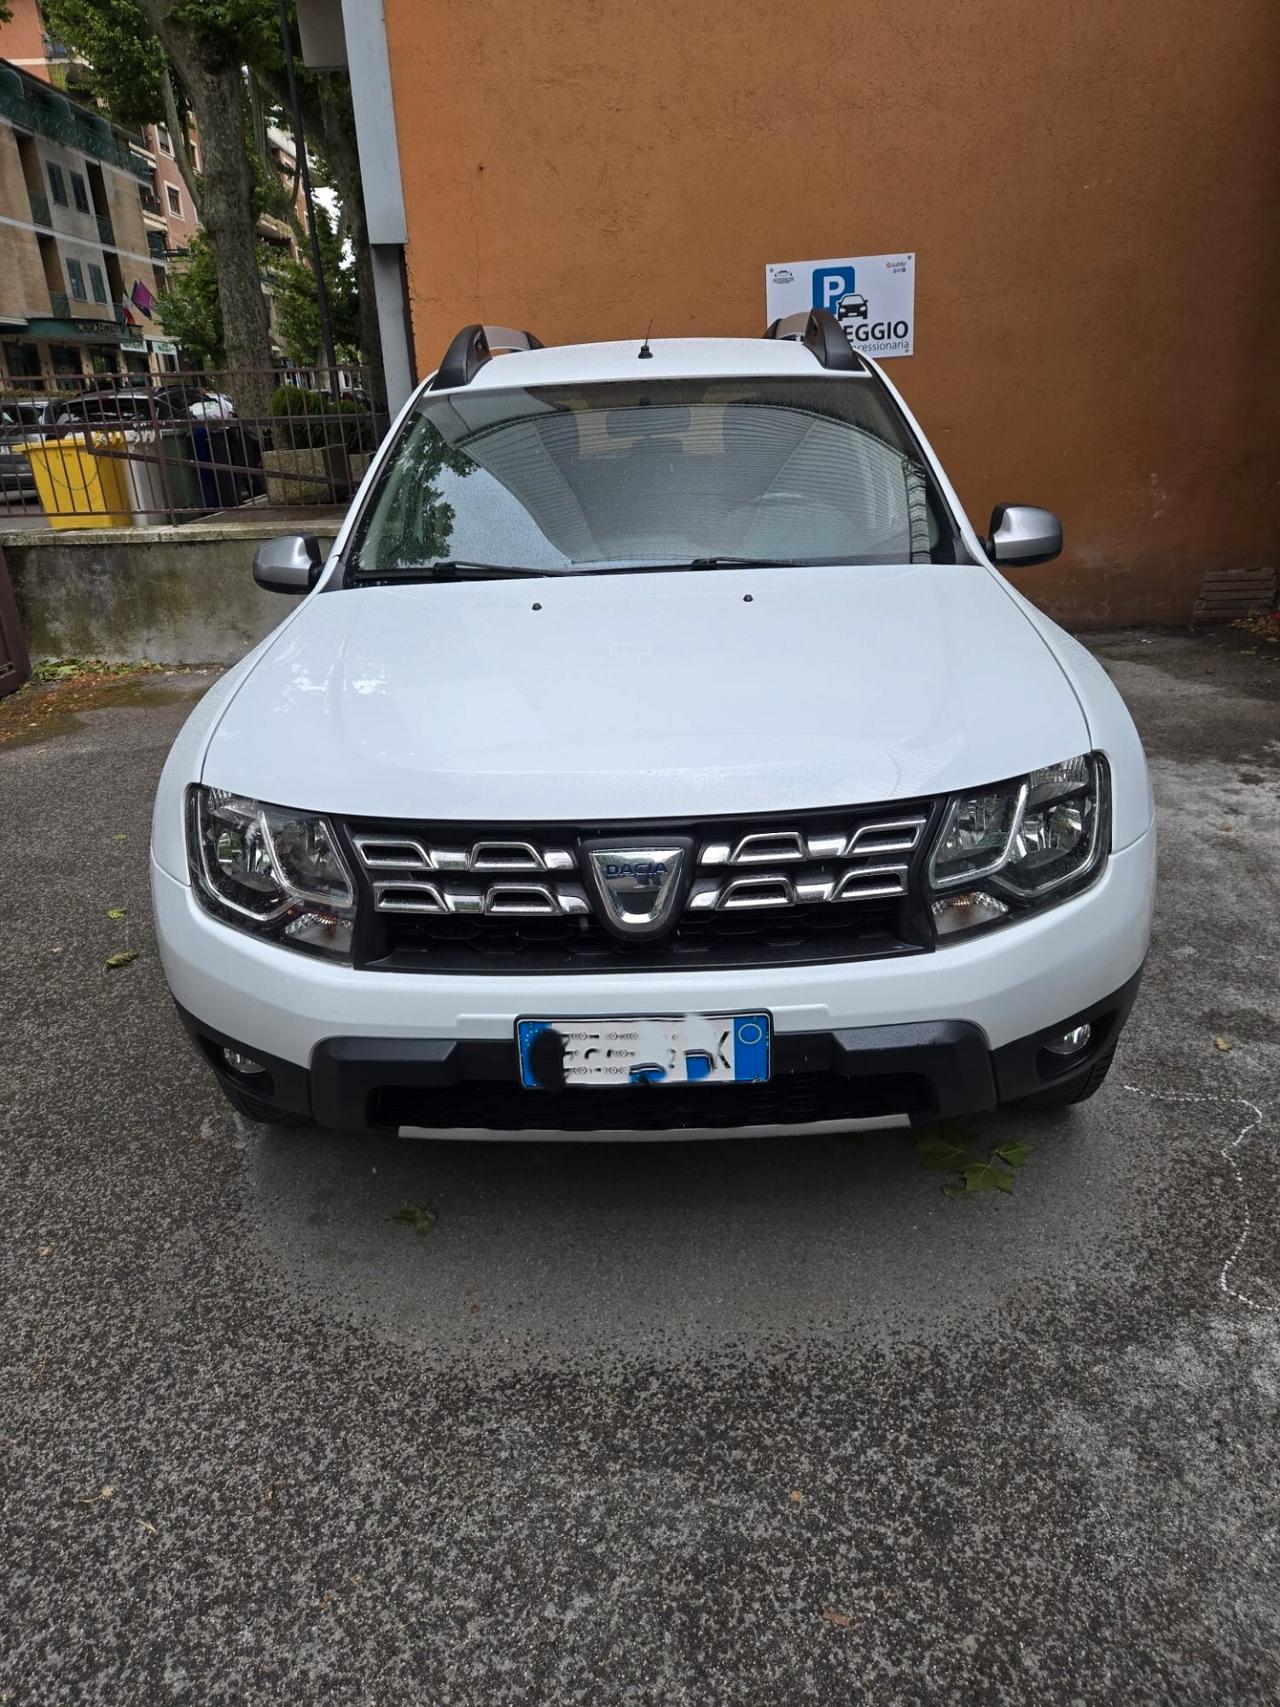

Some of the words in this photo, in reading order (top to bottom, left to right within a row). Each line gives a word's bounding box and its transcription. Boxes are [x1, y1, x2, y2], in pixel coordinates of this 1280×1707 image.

[823, 275, 846, 307] P
[843, 320, 909, 342] EGGIO
[605, 862, 667, 875] DACIA
